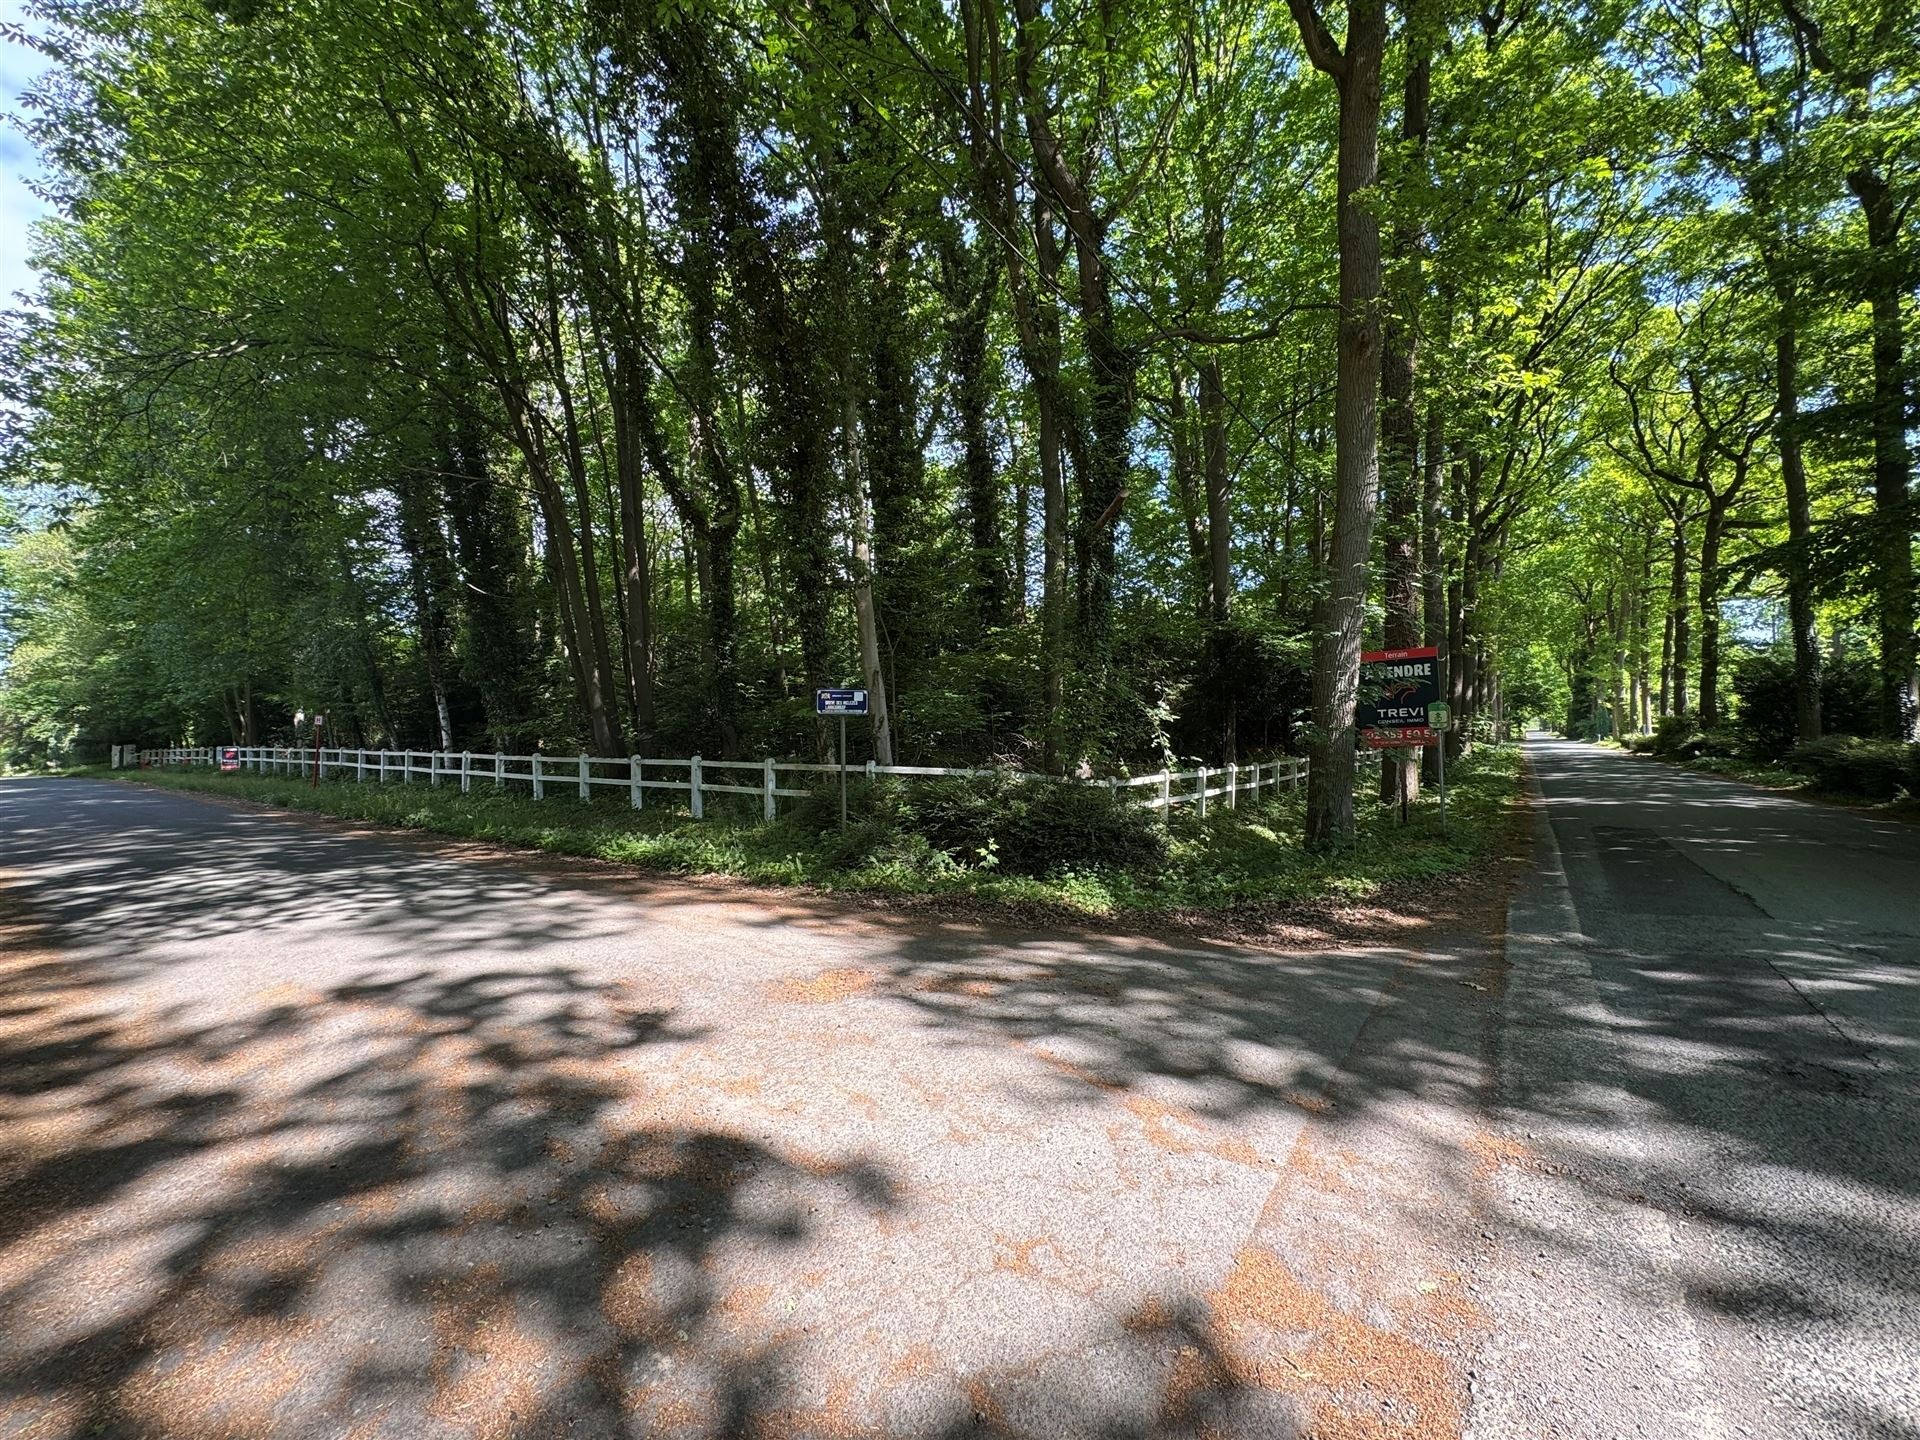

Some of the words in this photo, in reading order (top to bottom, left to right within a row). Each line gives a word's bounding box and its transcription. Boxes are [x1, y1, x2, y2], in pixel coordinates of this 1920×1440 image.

[1384, 651, 1408, 659] Terrain
[1377, 663, 1432, 678] ENDRE
[1377, 707, 1424, 718] TREVI
